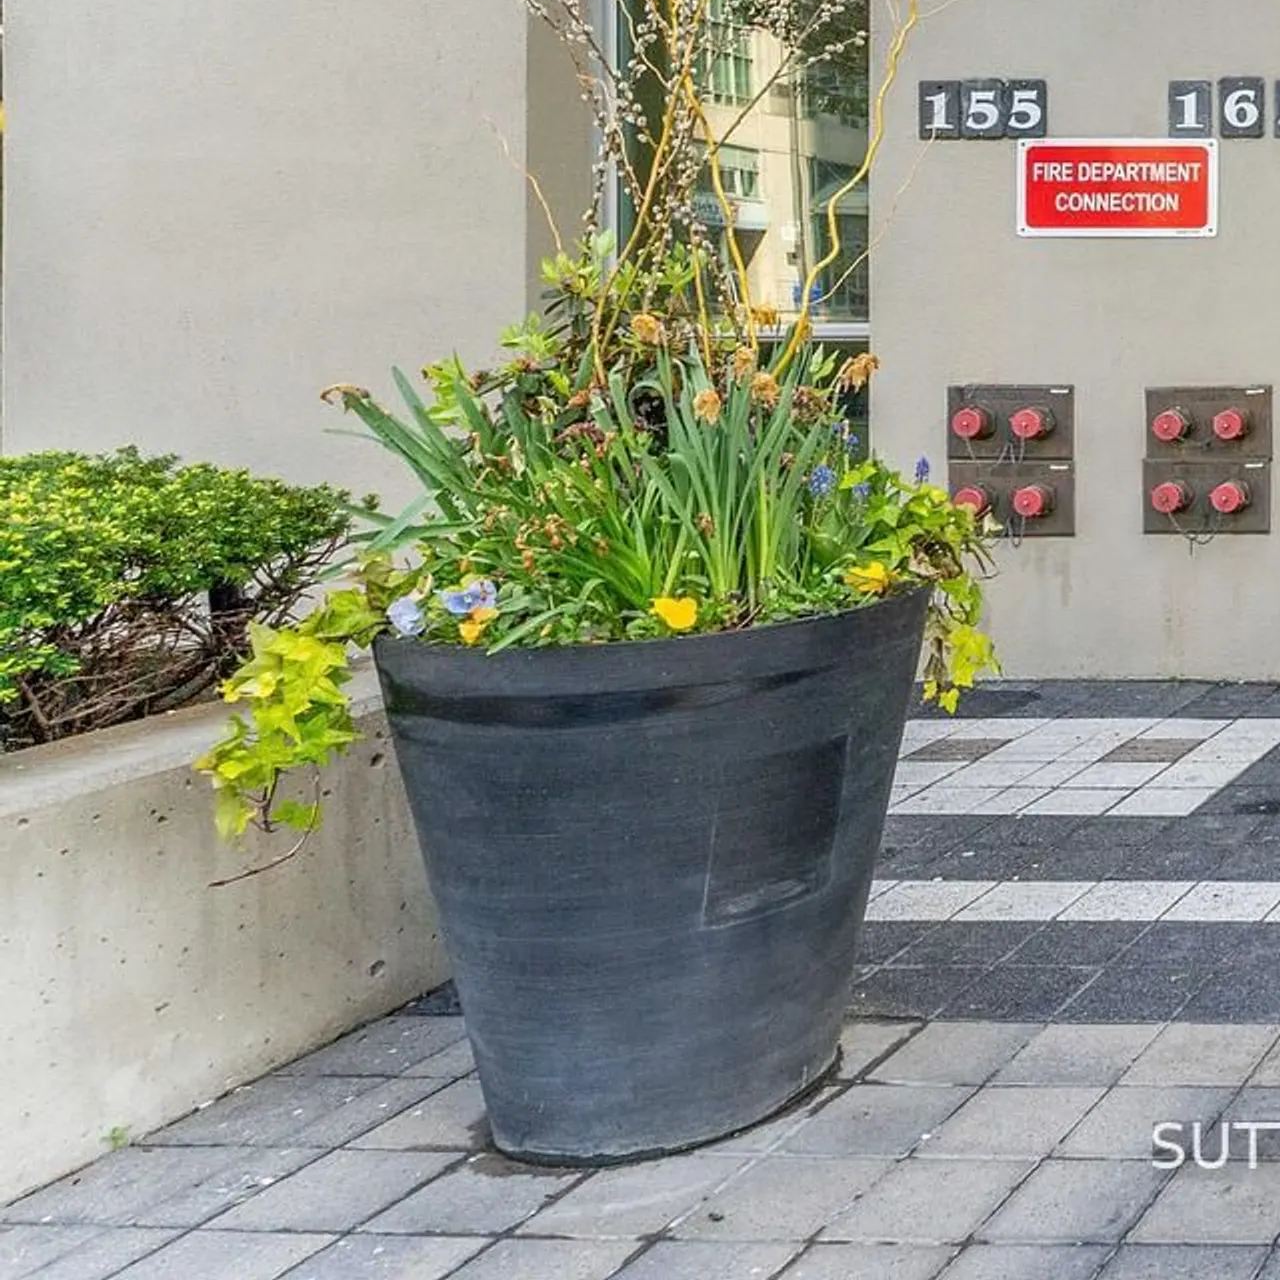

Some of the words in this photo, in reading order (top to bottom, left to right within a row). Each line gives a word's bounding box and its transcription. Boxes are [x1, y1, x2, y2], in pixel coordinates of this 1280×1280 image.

[925, 89, 1042, 129] 155
[1033, 162, 1073, 182] FIRE
[1078, 162, 1202, 182] DEPARTMENT
[1055, 192, 1180, 212] CONNECTION
